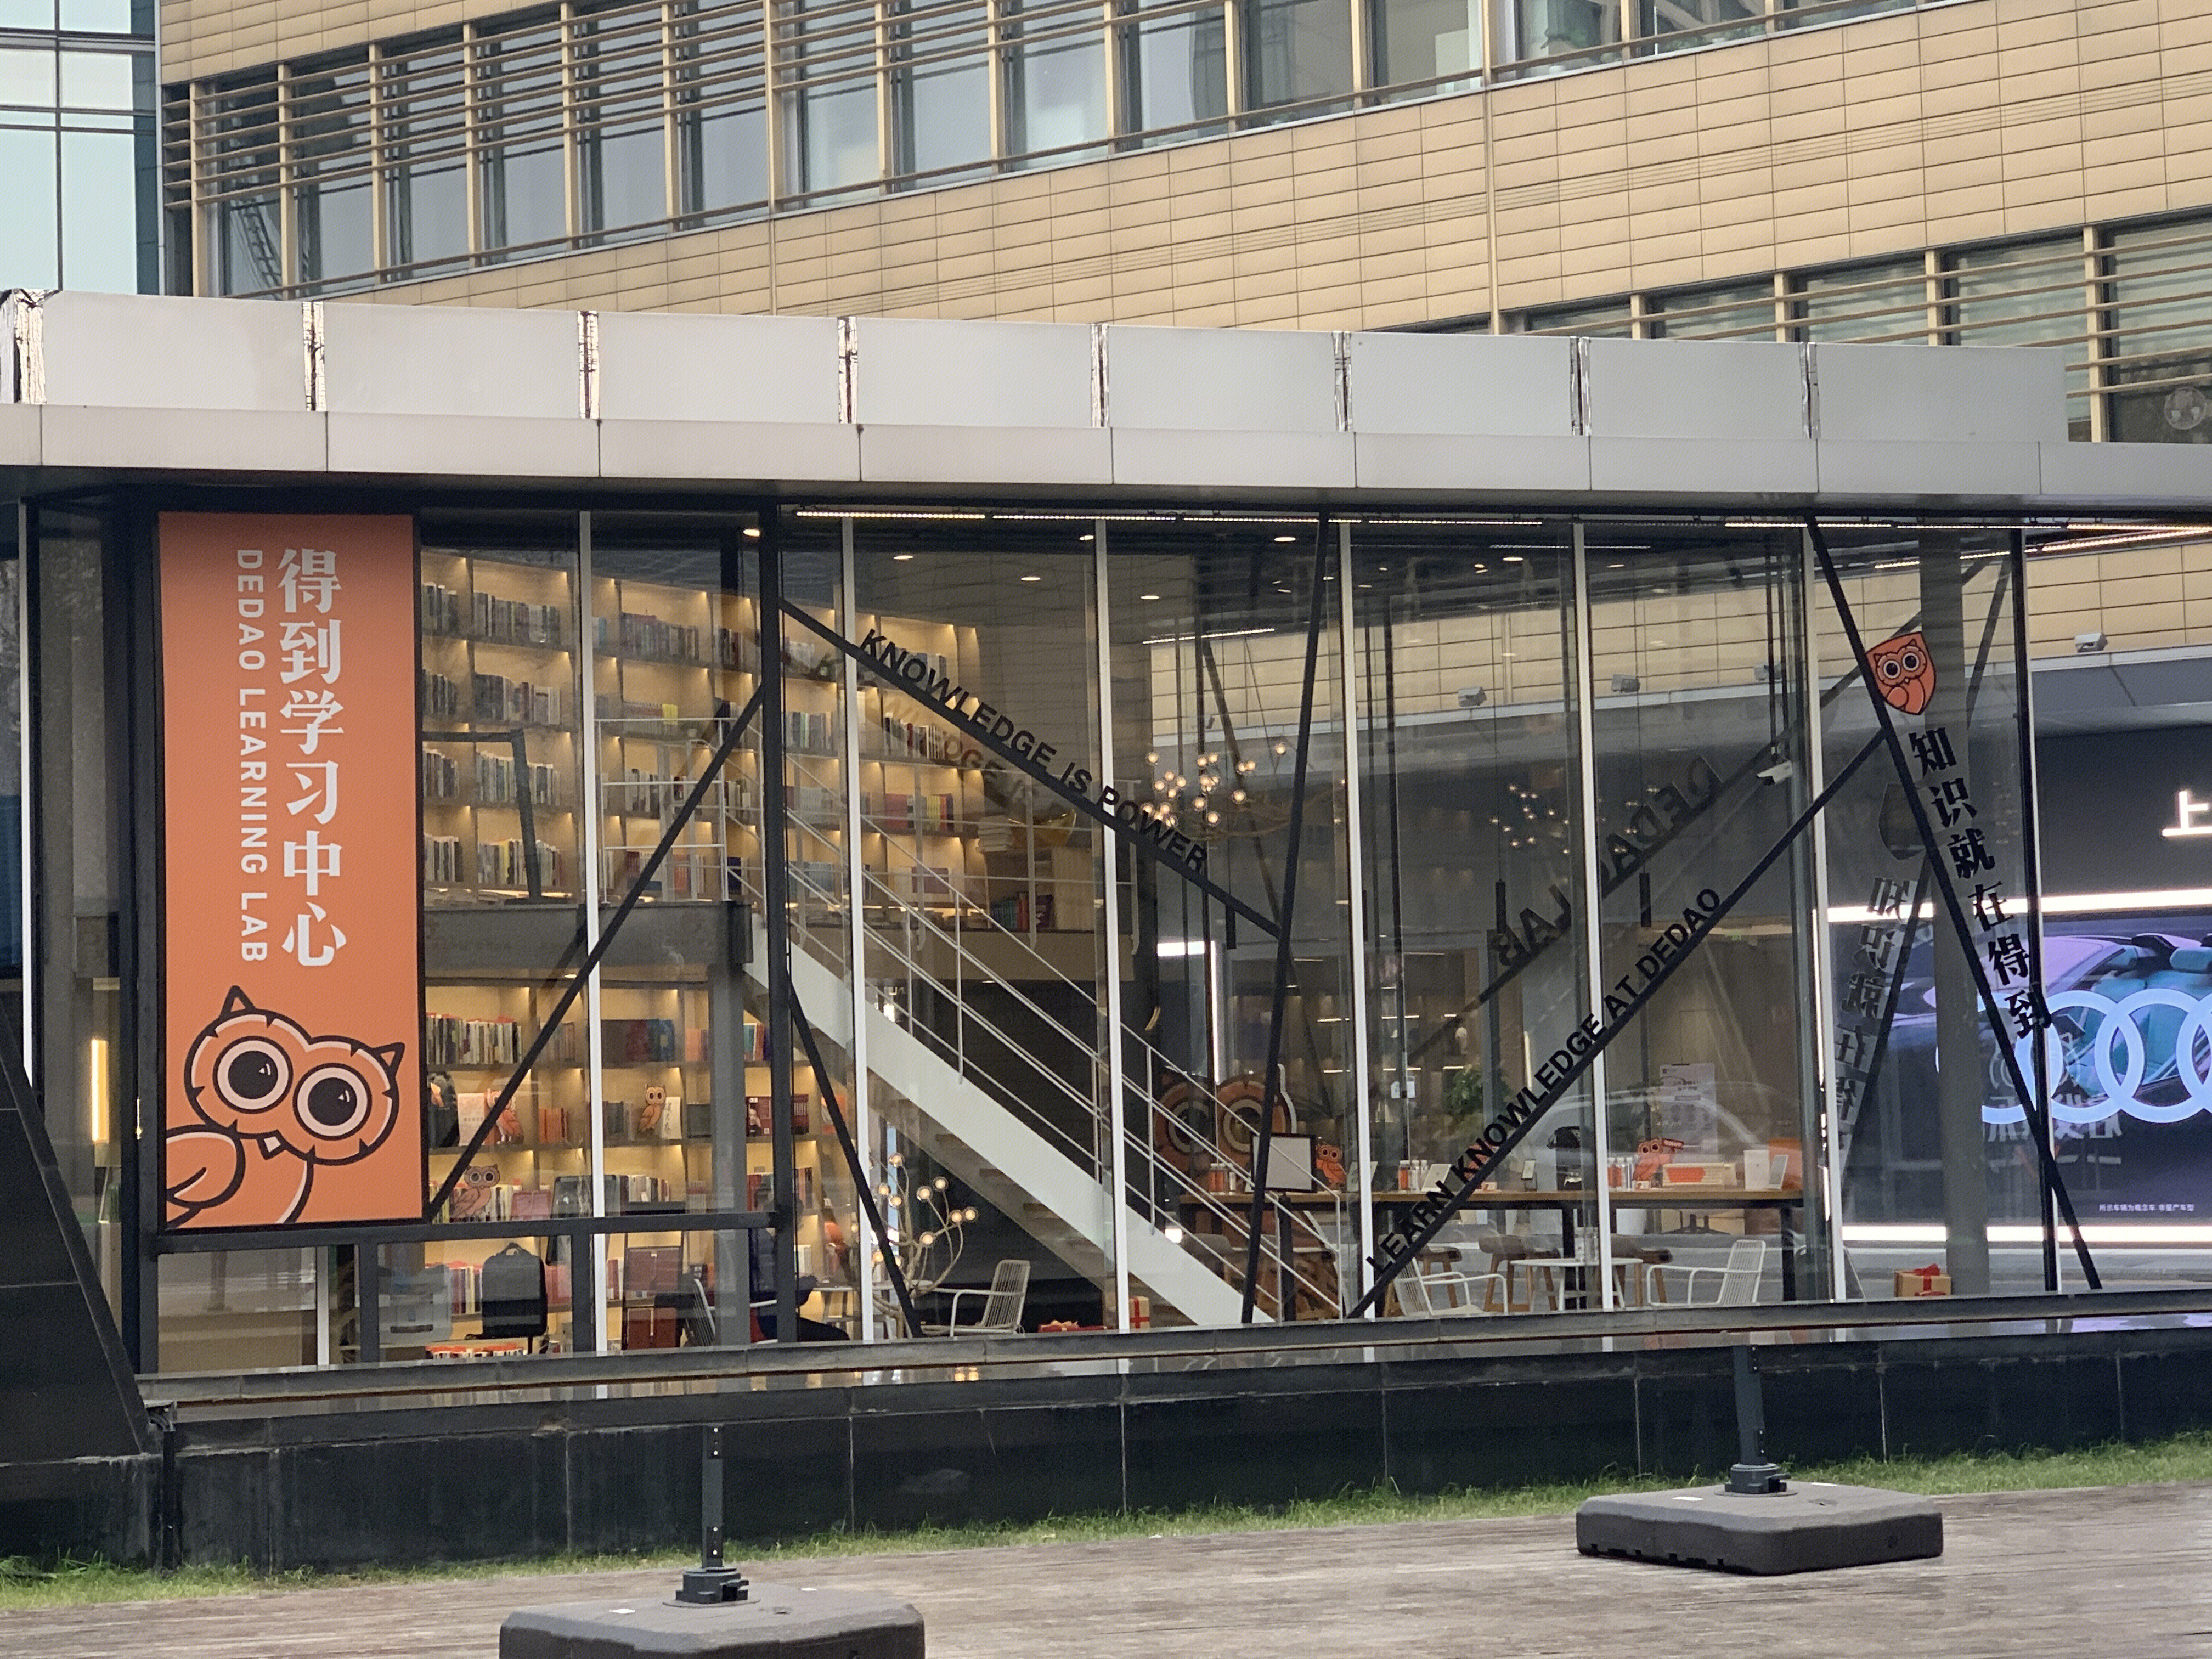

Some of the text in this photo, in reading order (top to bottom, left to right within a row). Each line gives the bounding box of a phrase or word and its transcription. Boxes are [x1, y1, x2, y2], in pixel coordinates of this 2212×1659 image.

[236, 549, 268, 962] DEDAO LEARNING LAB
[277, 548, 347, 967] 得到学习中心
[860, 629, 1057, 774] KNOWLEDGE
[1060, 762, 1092, 794] IS
[1097, 785, 1208, 873] POWER
[1909, 726, 2052, 1039] 知识就在得到
[1366, 888, 1720, 1275] LEARN KNOWLEDGE AT DEDAO
